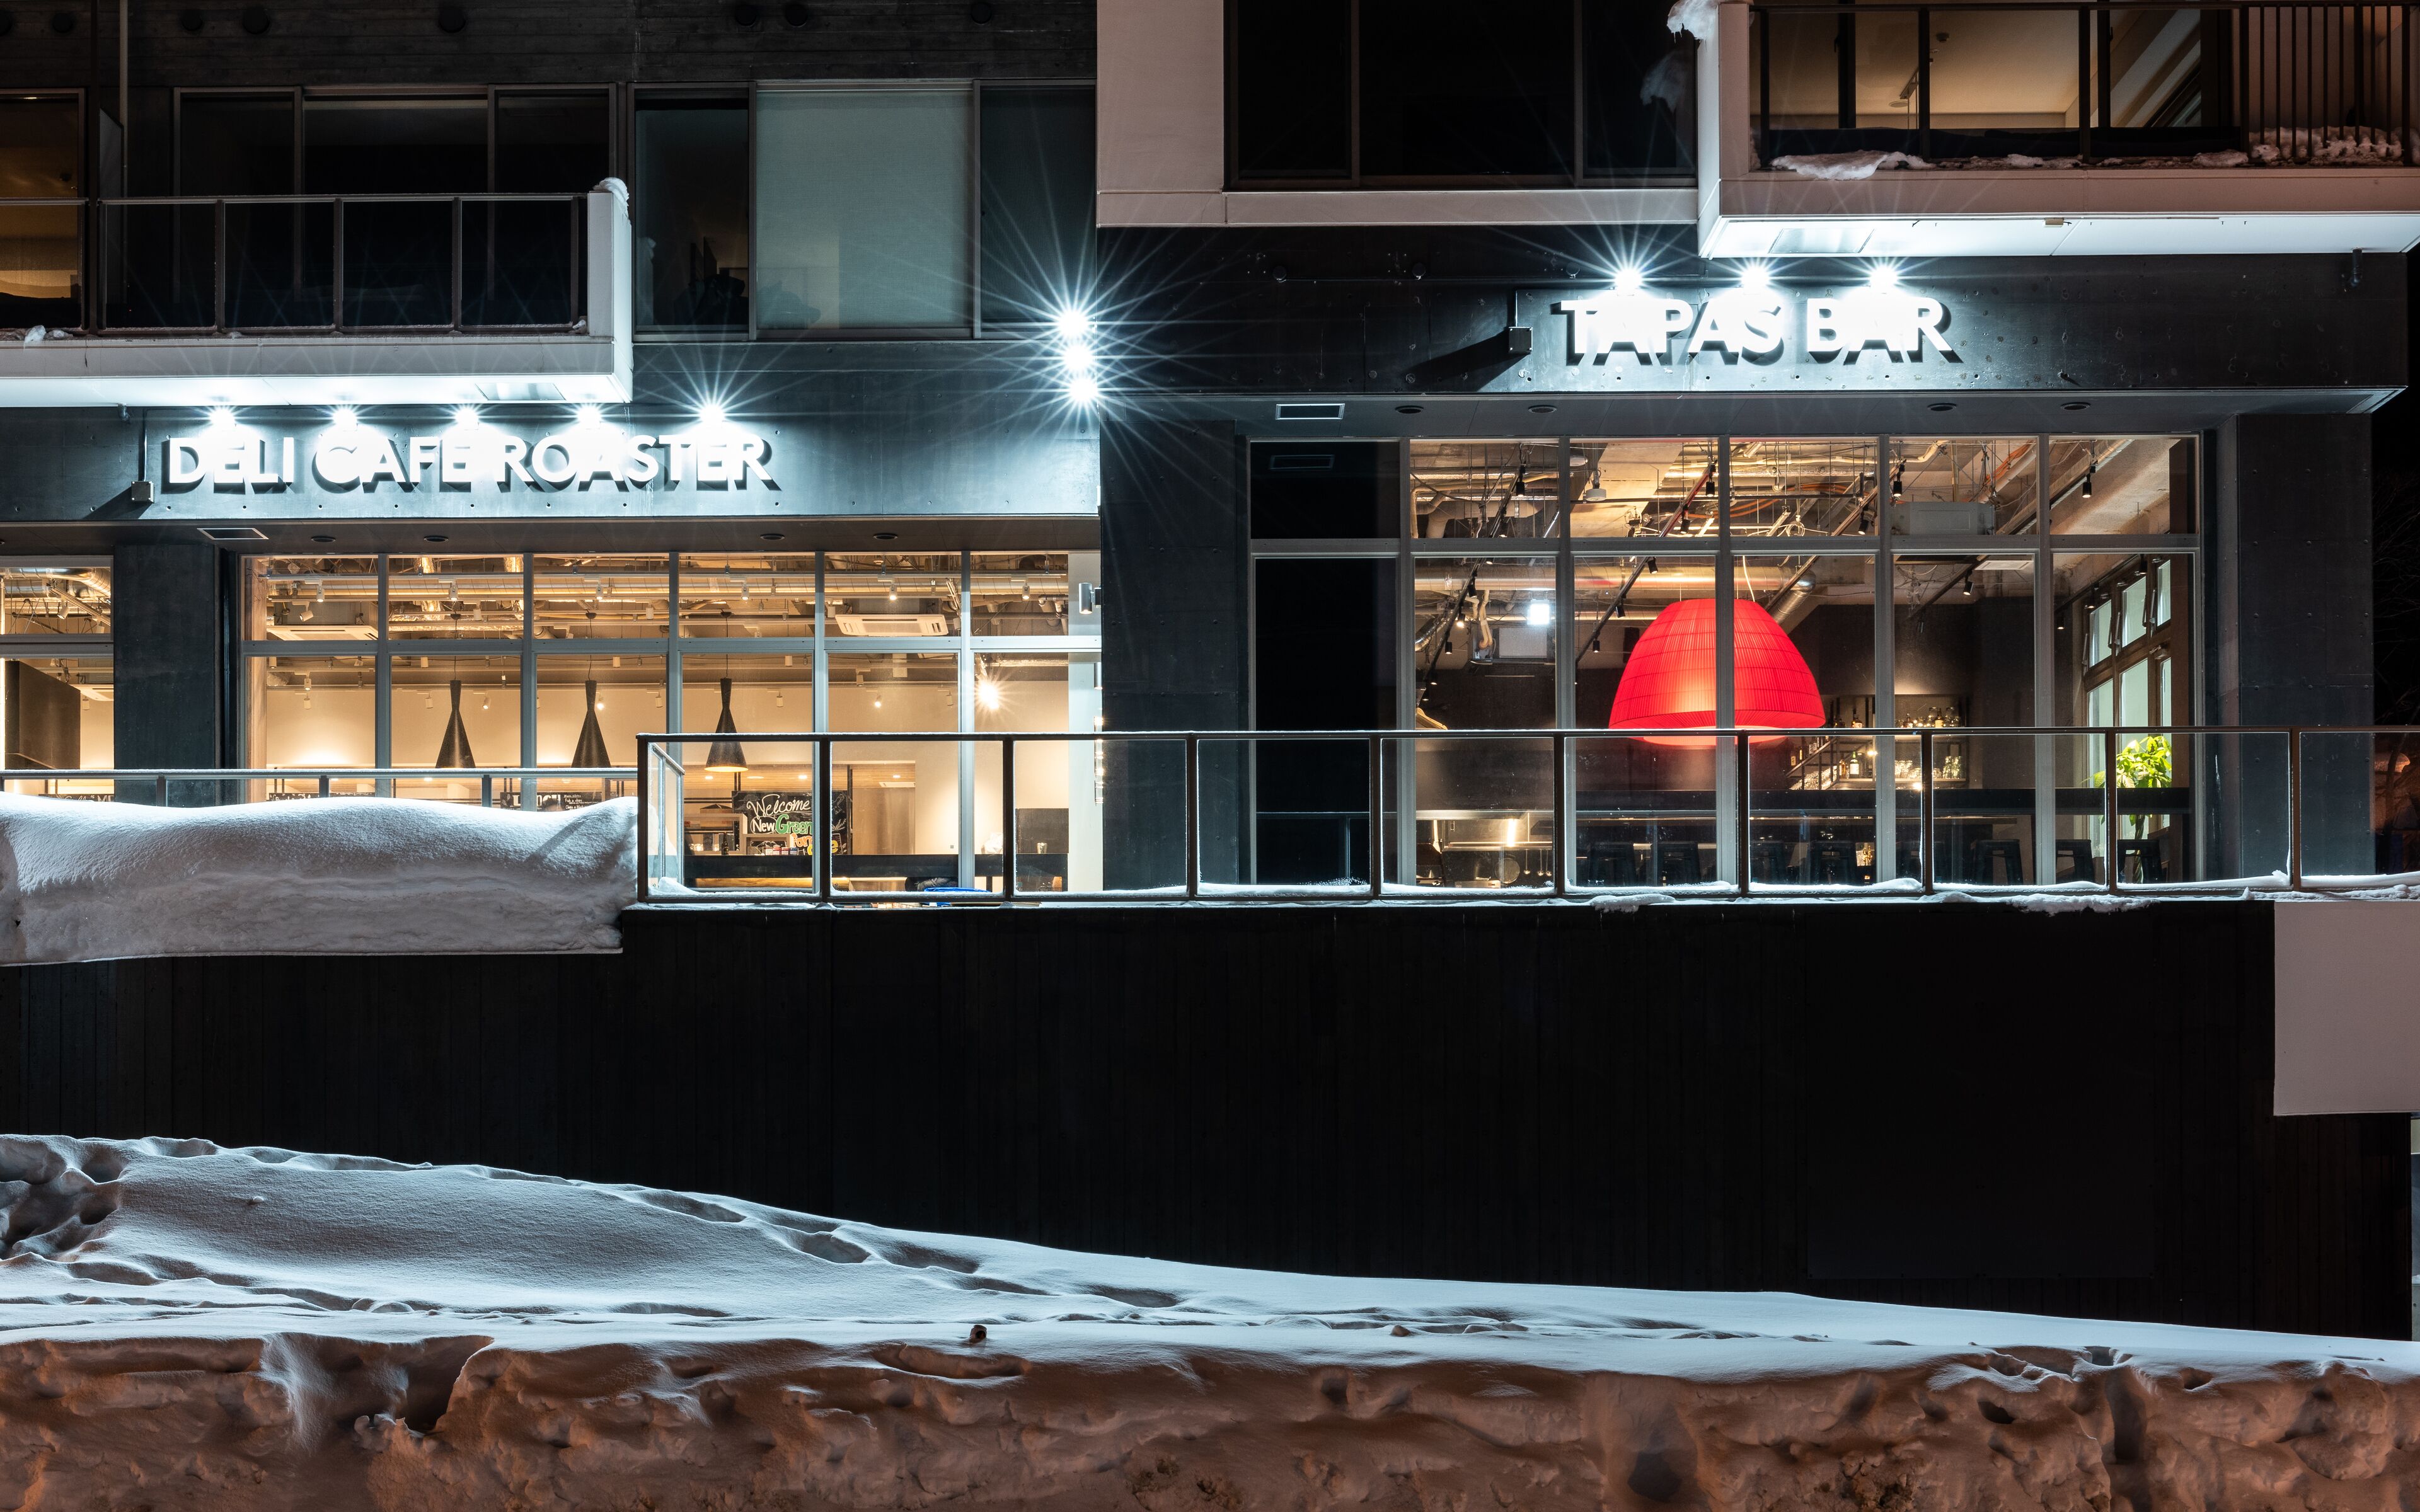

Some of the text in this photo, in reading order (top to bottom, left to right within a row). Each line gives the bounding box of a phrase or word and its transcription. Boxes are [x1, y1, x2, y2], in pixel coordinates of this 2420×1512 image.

[1560, 297, 1953, 353] TAPAS BAR
[169, 434, 772, 484] DELI CAFE ROASTER
[746, 793, 812, 820] Welcome
[752, 814, 813, 835] New Green
